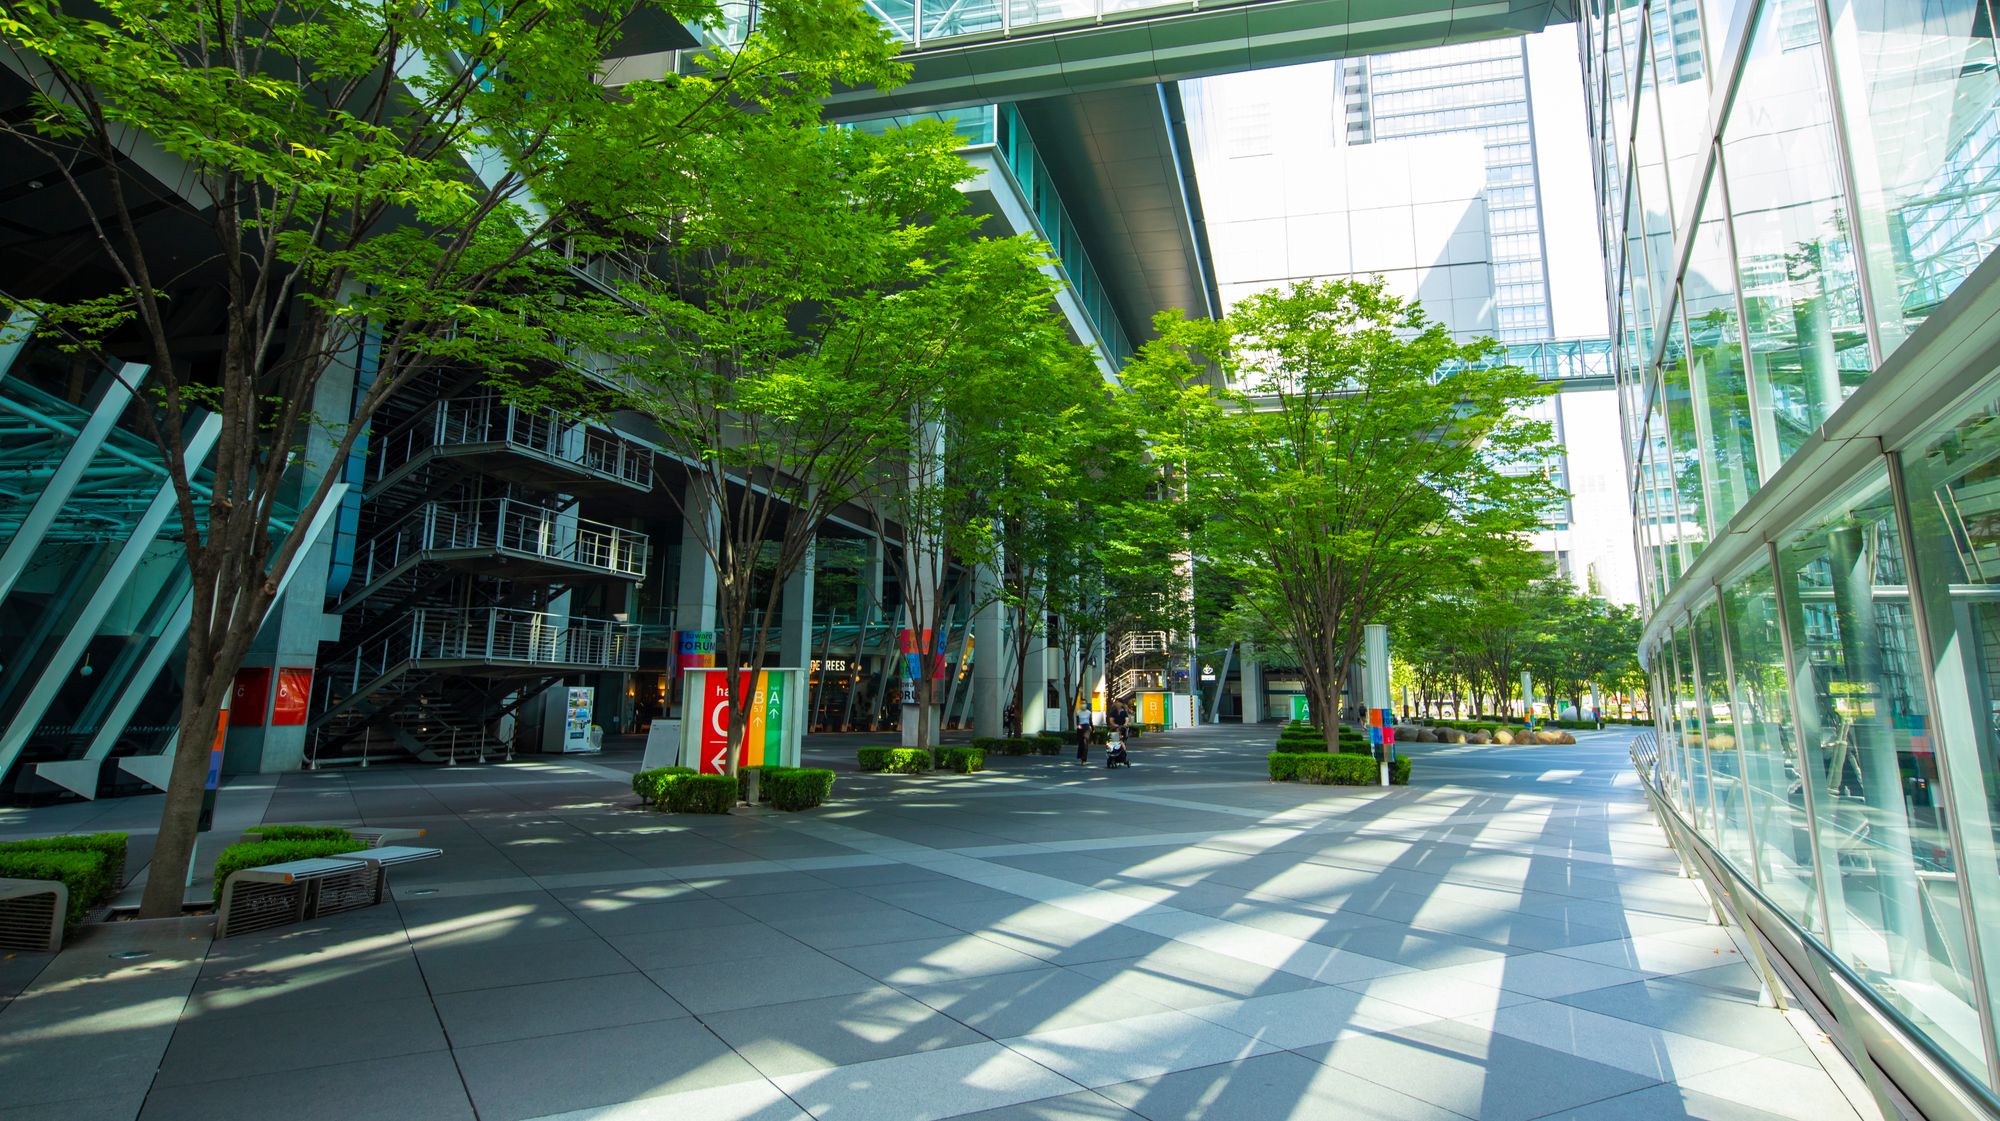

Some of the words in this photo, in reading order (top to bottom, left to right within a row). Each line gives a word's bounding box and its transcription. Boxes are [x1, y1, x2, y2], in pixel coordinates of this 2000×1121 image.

[686, 632, 713, 640] toward
[280, 687, 287, 697] C
[753, 691, 764, 704] B
[769, 691, 780, 705] A
[1301, 703, 1309, 713] A
